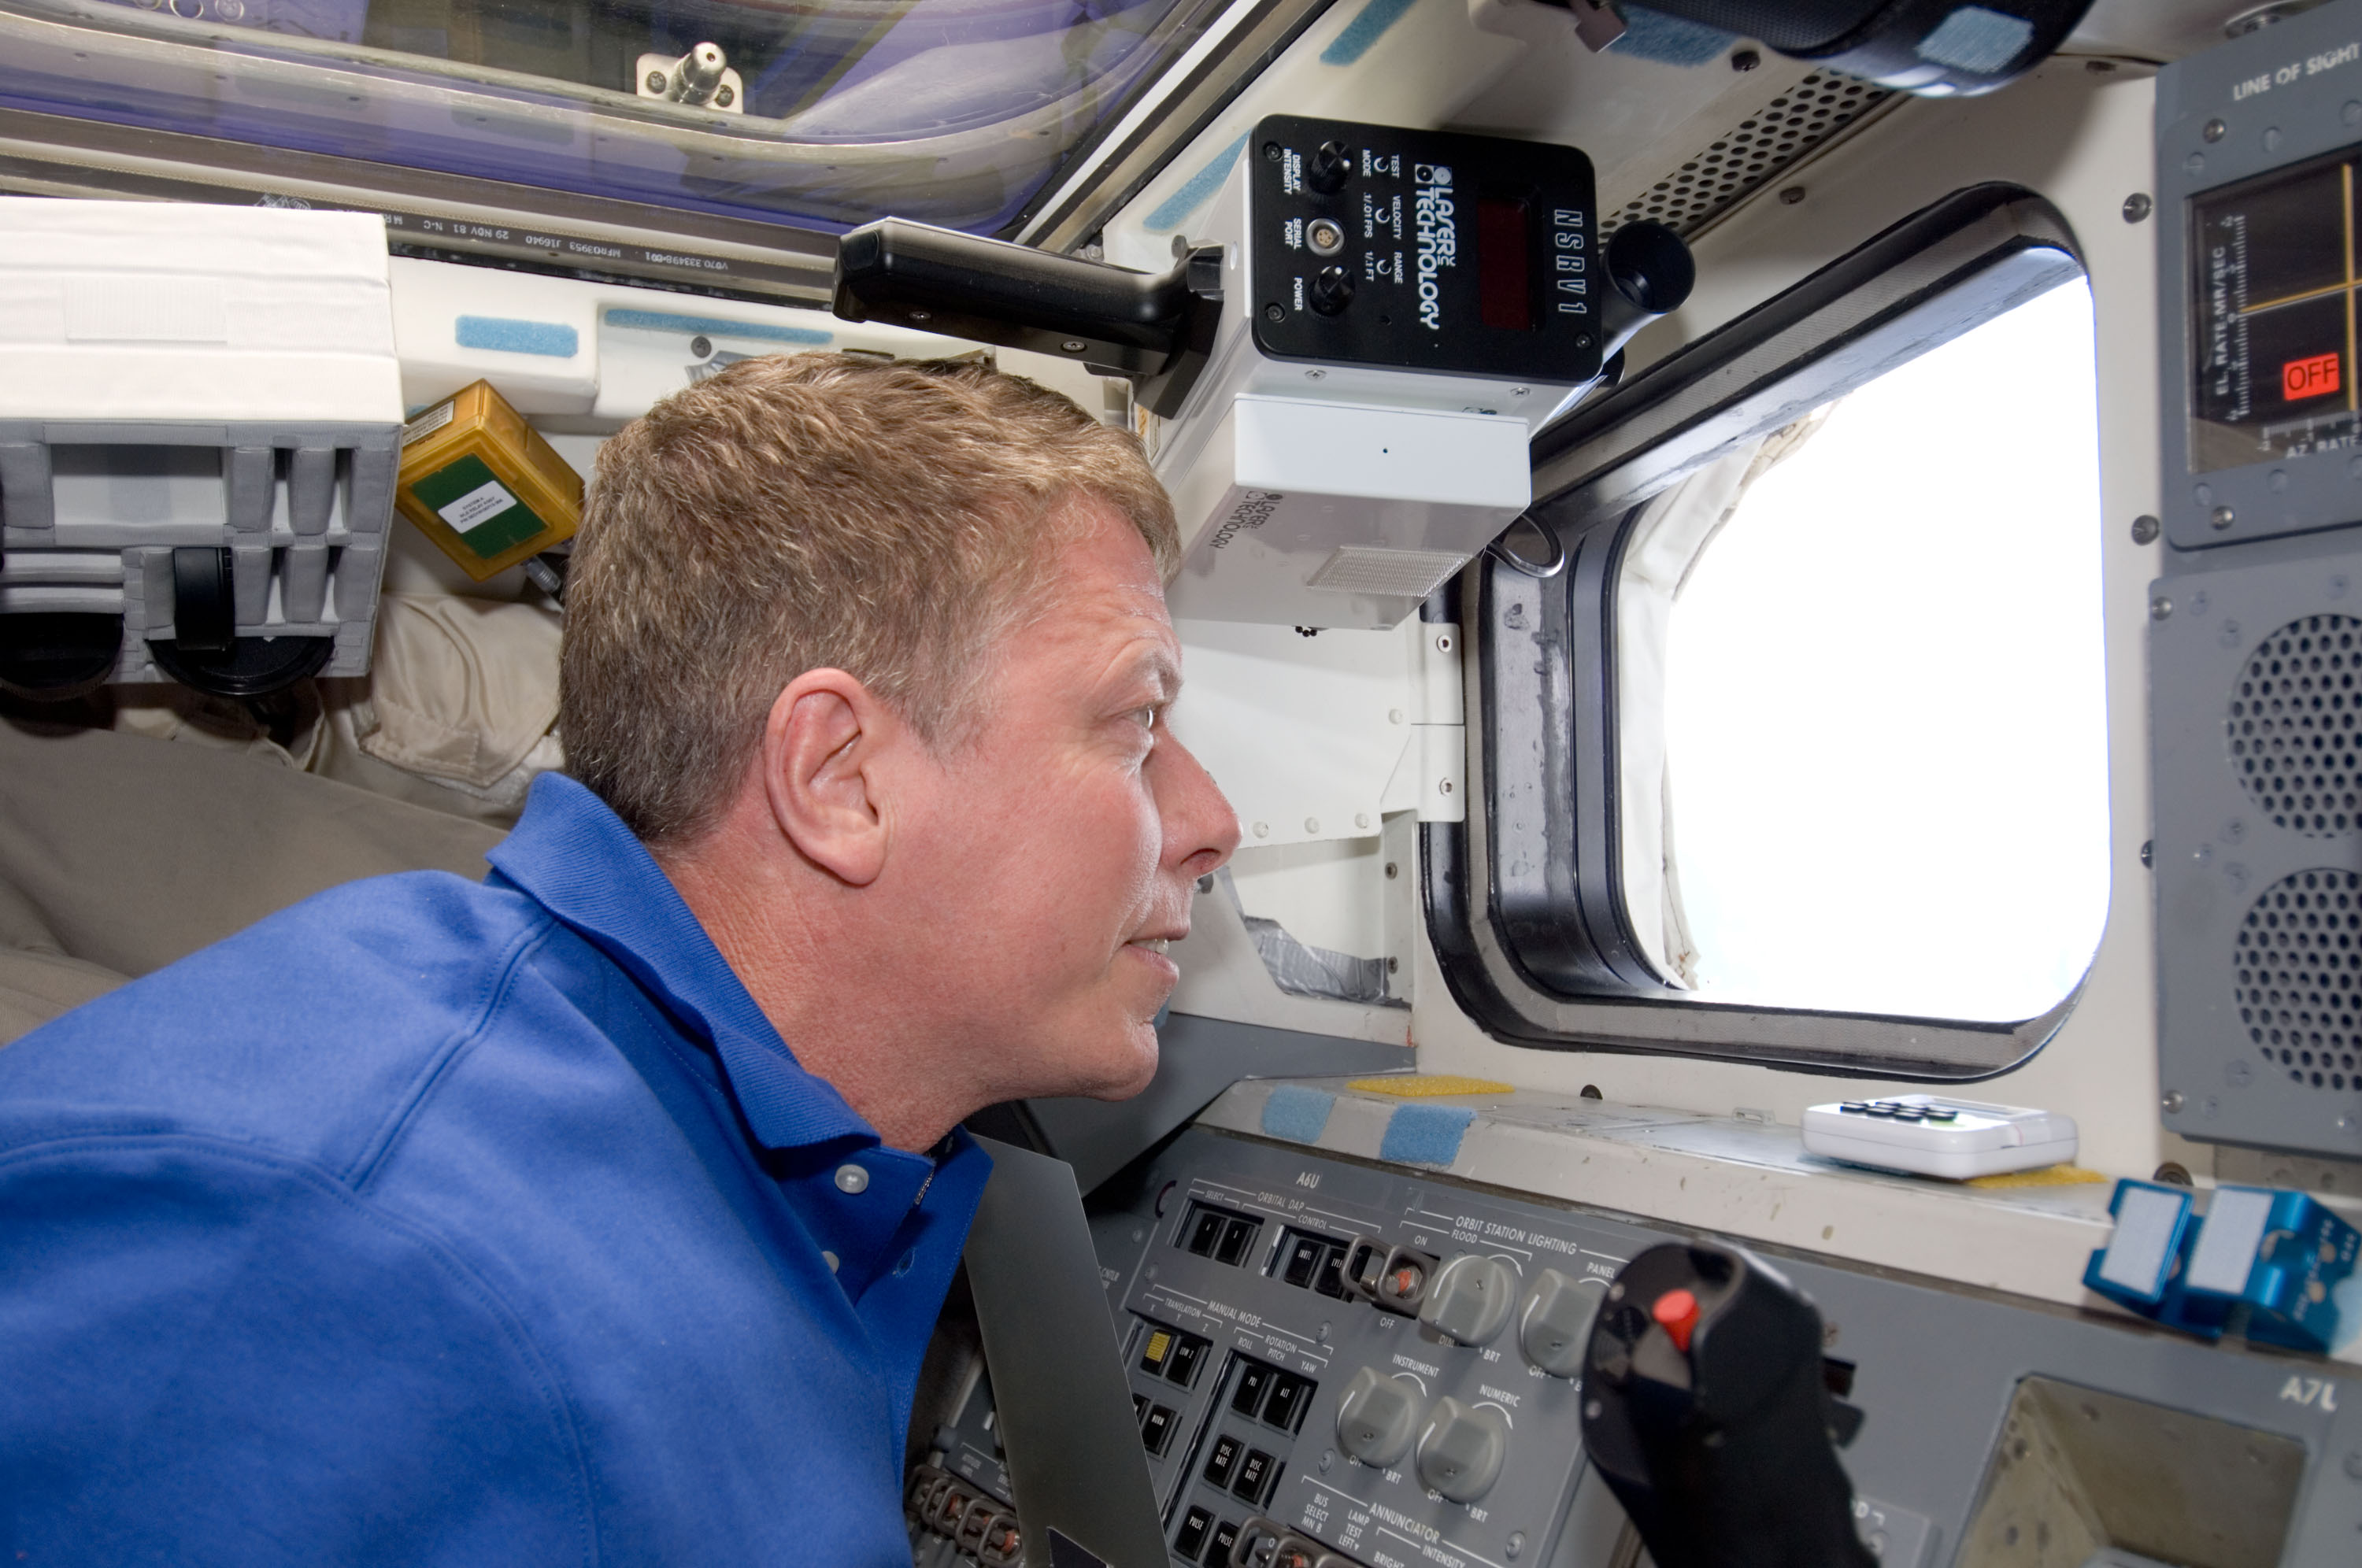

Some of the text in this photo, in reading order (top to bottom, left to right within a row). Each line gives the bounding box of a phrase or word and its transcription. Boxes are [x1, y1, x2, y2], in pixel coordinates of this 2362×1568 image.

[2233, 42, 2360, 102] LINE OF SIGHT
[1284, 148, 1293, 195] INTENSITY
[1293, 153, 1301, 191] DISPLAY
[1362, 149, 1372, 177] MODE
[1390, 153, 1400, 178] TEST
[1393, 194, 1402, 240] VELOCITY
[1435, 187, 1456, 256] LASER
[495, 230, 510, 240] 29
[1285, 220, 1294, 246] PORT
[1293, 217, 1302, 250] SERIAL
[1416, 186, 1440, 330] TECHNOLOGY
[1394, 251, 1403, 284] RANGE
[1294, 277, 1303, 311] POWER
[2287, 357, 2338, 391] OFF
[1296, 1171, 1320, 1189] A6U
[1205, 1190, 1225, 1202] SELECT
[1257, 1192, 1305, 1211] ORBITAL DAP
[1298, 1215, 1327, 1230] CONTROL
[1414, 1235, 1428, 1247] ON
[1451, 1229, 1478, 1244] FLOOD
[1456, 1215, 1578, 1256] ORBIT STATION LIGHTING
[1586, 1262, 1616, 1279] PANEL
[1164, 1298, 1202, 1319] TRANSLATION
[1207, 1300, 1262, 1328] MANUAL MODE
[1201, 1322, 1209, 1332] Z
[1379, 1317, 1395, 1329] OFF
[1238, 1337, 1253, 1351] ROLL
[1264, 1334, 1298, 1355] ROTATION
[1438, 1334, 1456, 1348] DIM
[1267, 1348, 1286, 1362] PITCH
[1483, 1348, 1501, 1363] BRT
[1300, 1360, 1318, 1374] YAW
[1392, 1353, 1440, 1378] INSTRUMENT
[1279, 1387, 1290, 1399] ALT
[1479, 1383, 1521, 1408] NUMERIC
[1215, 1454, 1228, 1467] RATE
[1245, 1469, 1258, 1482] RATE
[1386, 1470, 1402, 1485] BRT
[1313, 1492, 1330, 1508] BUS
[1304, 1503, 1330, 1522] SELECT
[1347, 1509, 1371, 1527] LAMP
[1470, 1506, 1489, 1523] BRT
[1189, 1515, 1205, 1531] PULSE
[1301, 1516, 1323, 1534] MN B
[1346, 1523, 1364, 1540] TEST
[1368, 1502, 1441, 1545] ANNUNCIATOR
[1217, 1532, 1234, 1548] PULSE
[1338, 1534, 1356, 1551] LEFT
[1422, 1544, 1467, 1568] INTENSITY
